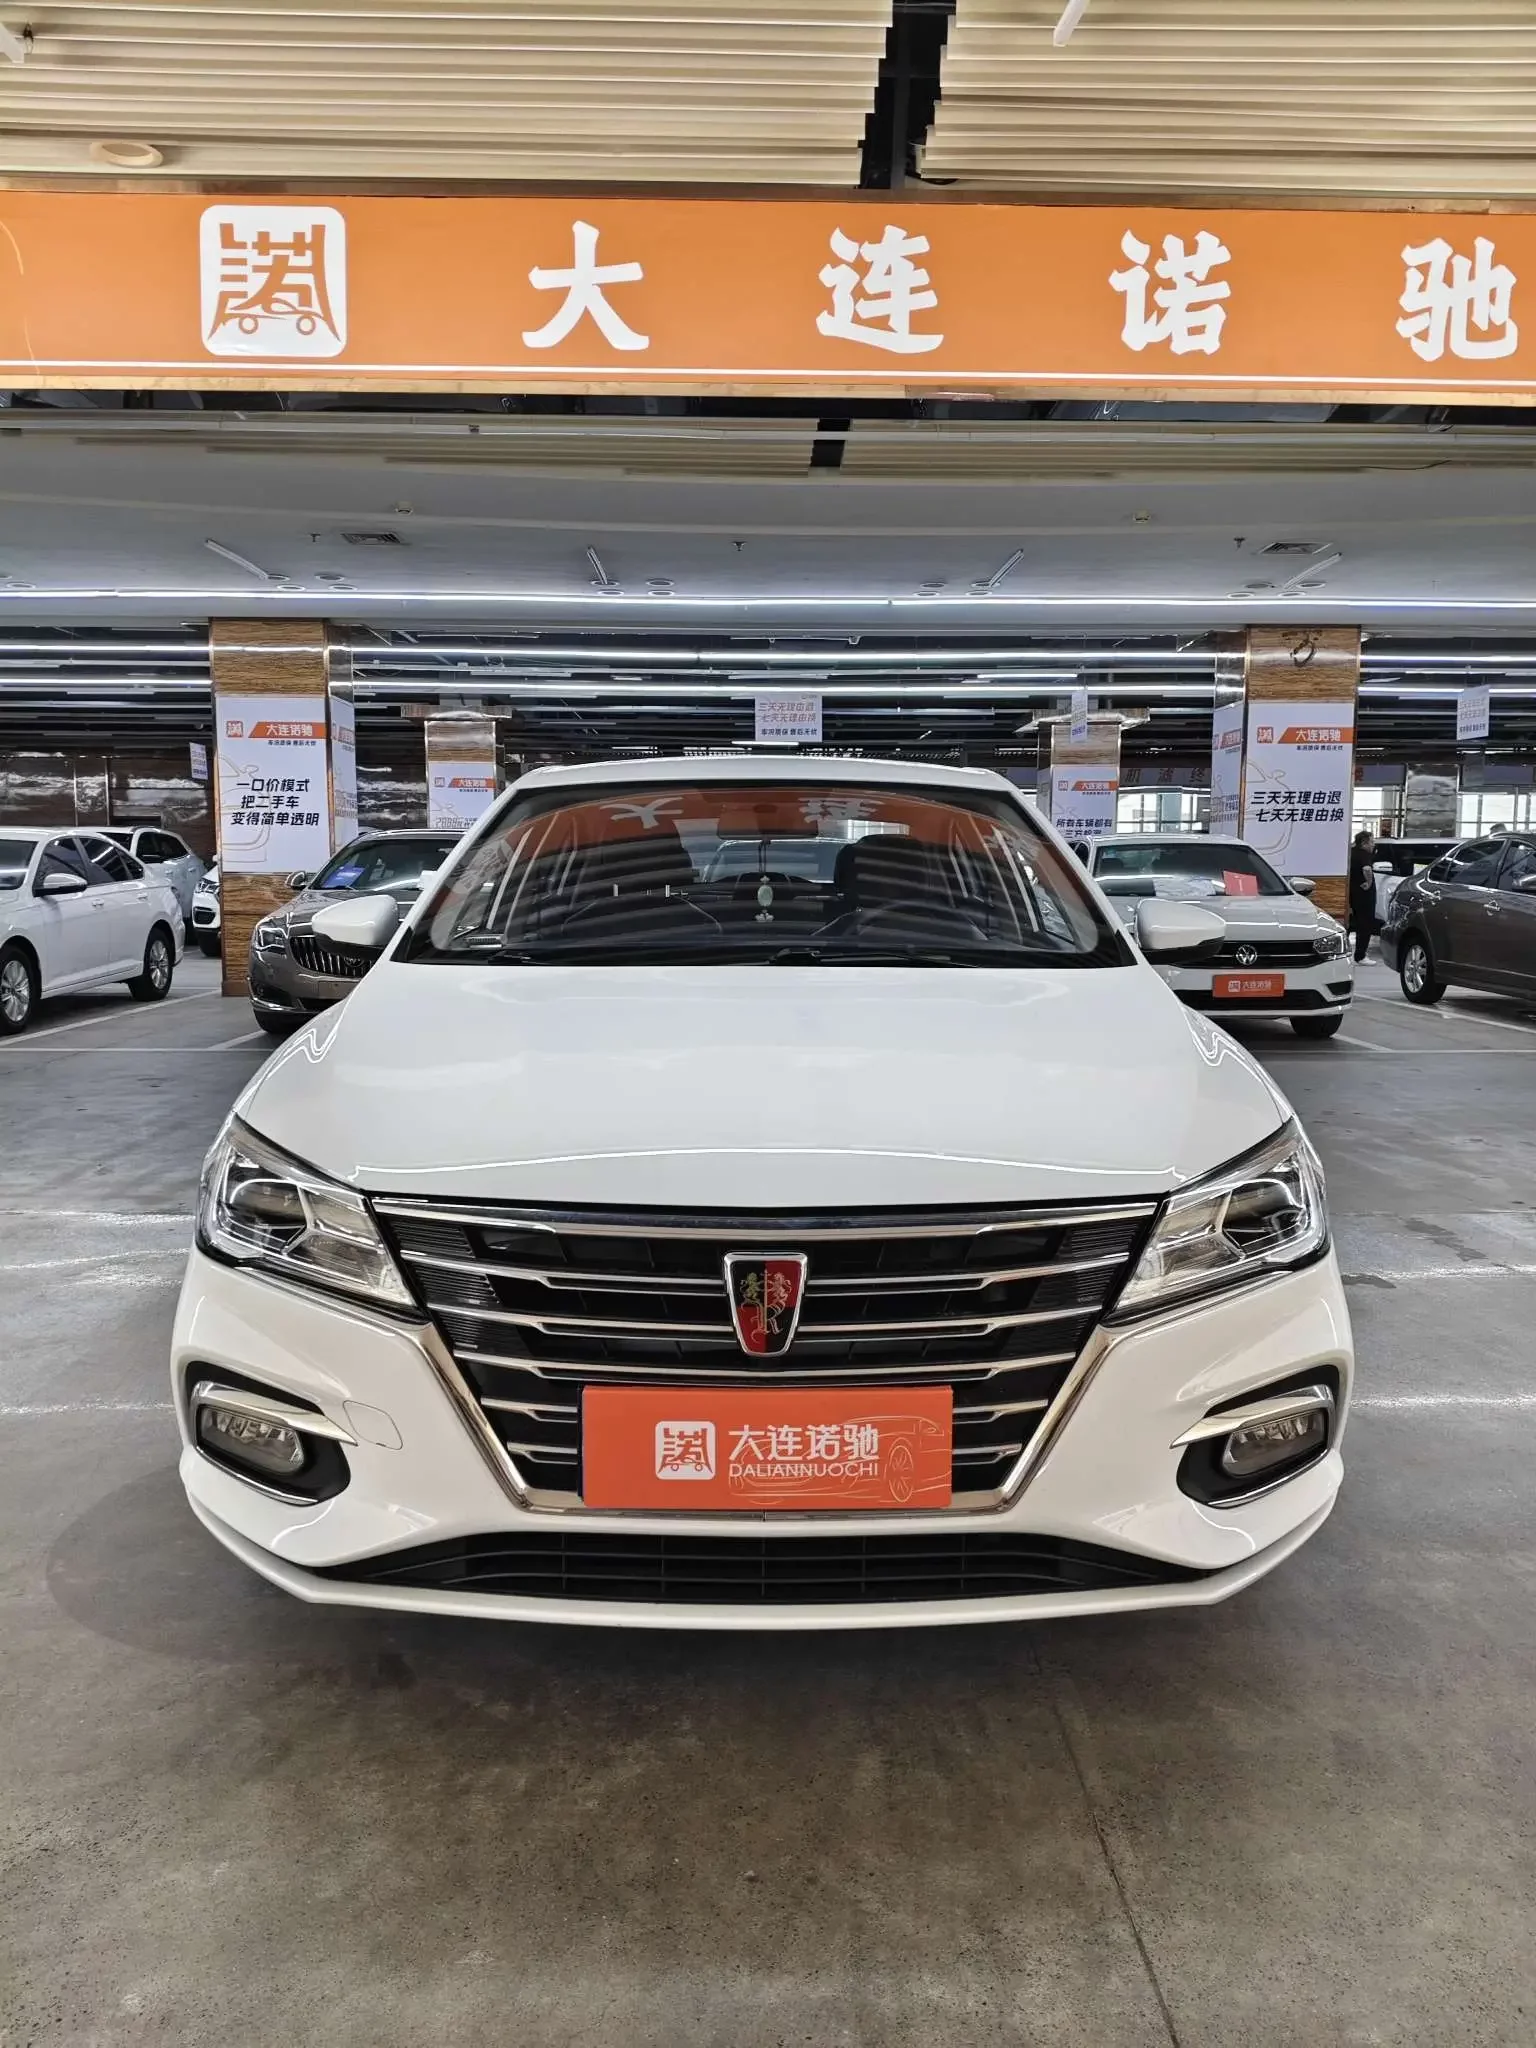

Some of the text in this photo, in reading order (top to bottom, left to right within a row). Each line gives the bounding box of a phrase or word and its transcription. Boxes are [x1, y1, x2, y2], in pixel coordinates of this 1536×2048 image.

[522, 219, 1517, 362] 大连诺驰
[236, 778, 310, 793] 一口价模式
[240, 795, 300, 809] 把二手车
[1251, 790, 1342, 805] 三天无理由退
[230, 811, 320, 826] 变得简单透明
[1255, 808, 1345, 822] 七天无理由换
[728, 1424, 880, 1462] 大连诺驰
[729, 1463, 879, 1478] DALIANNUOCHI
